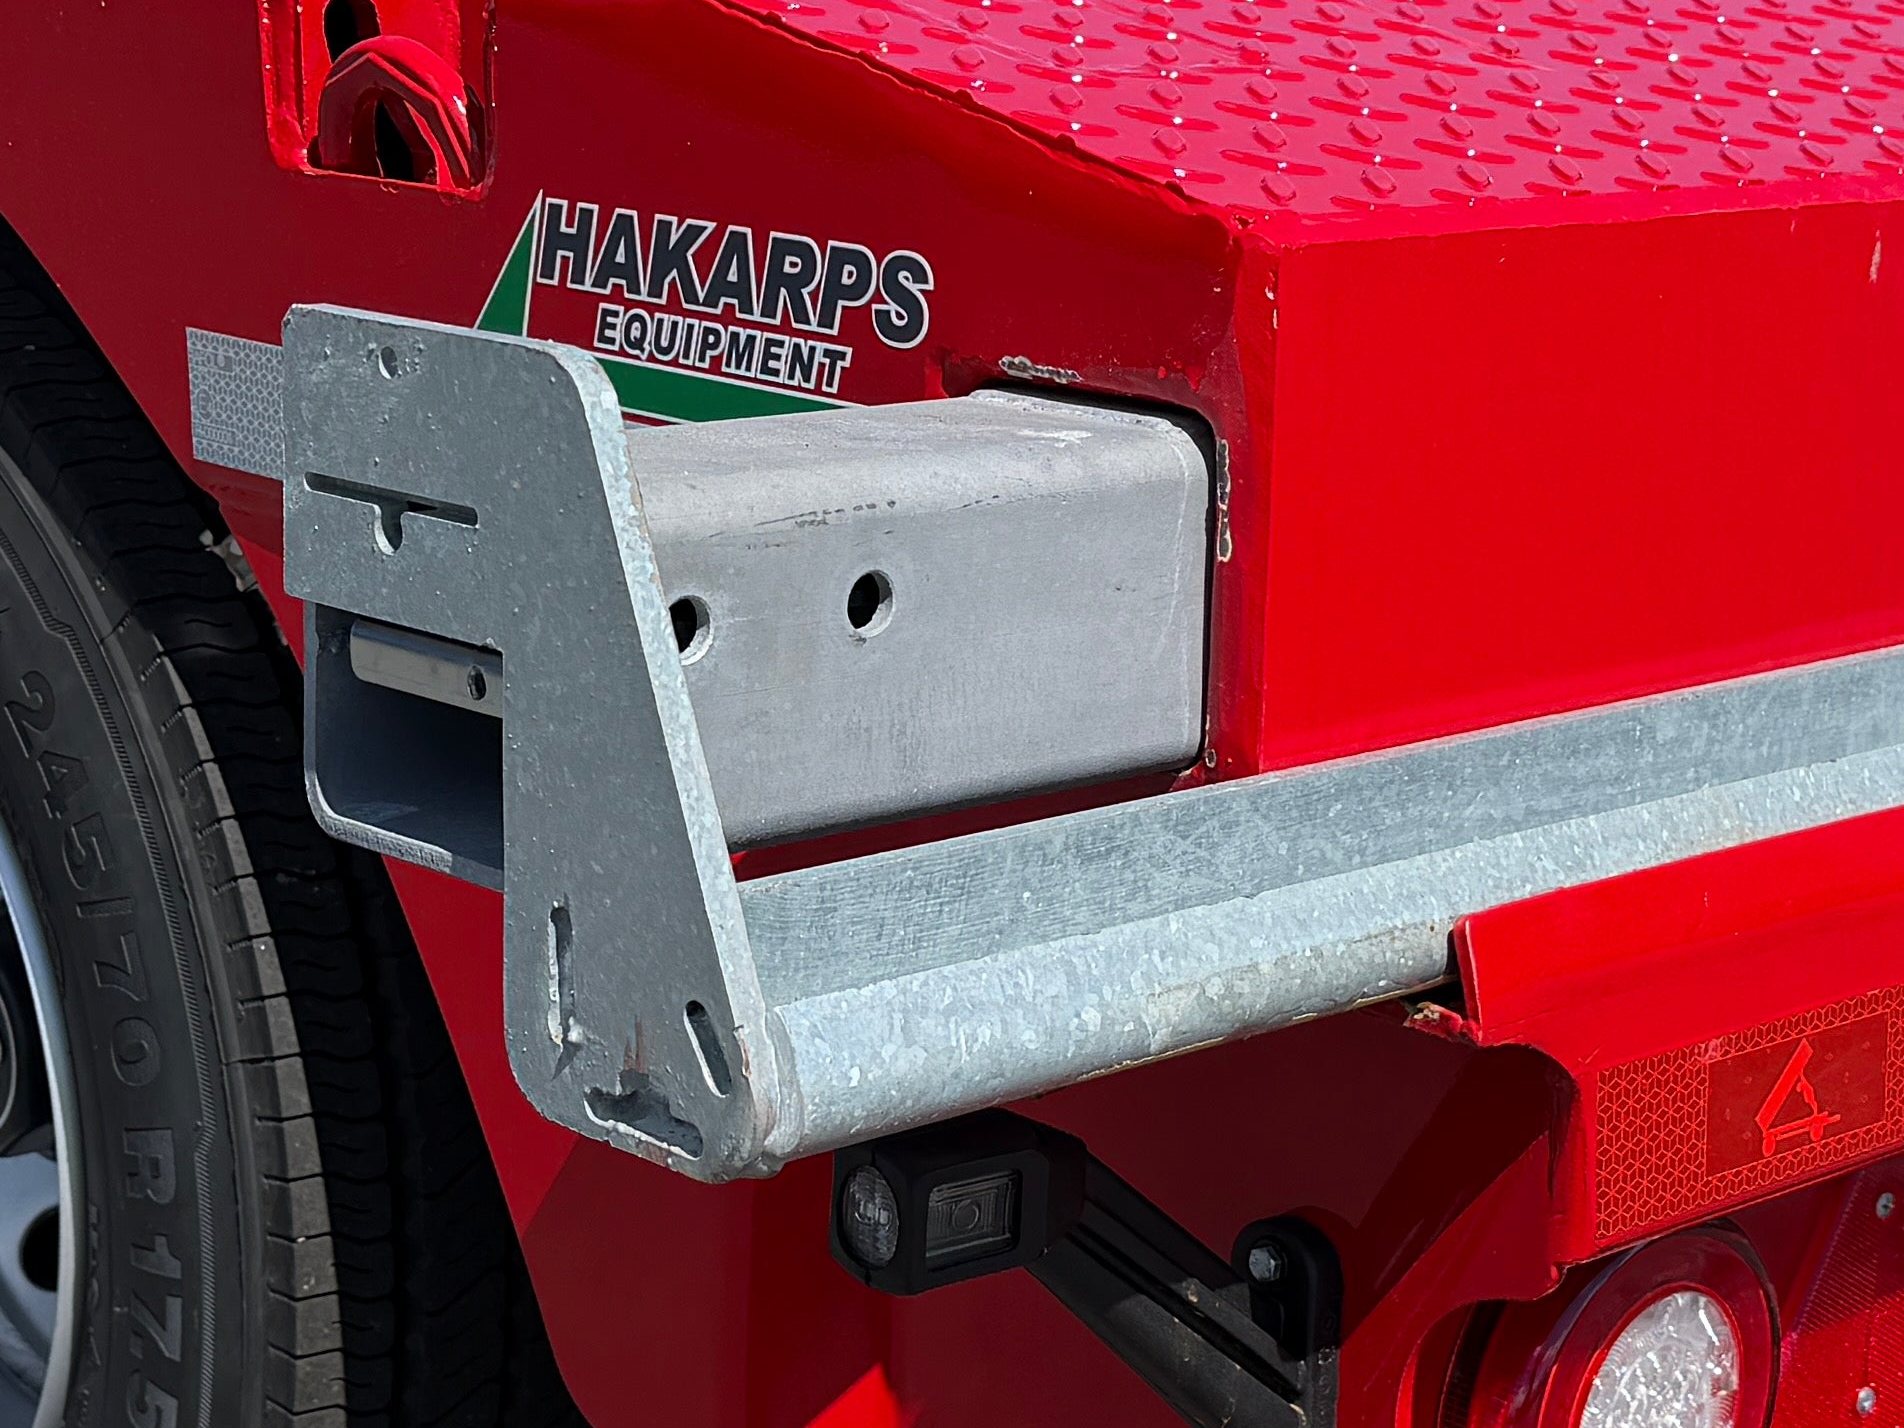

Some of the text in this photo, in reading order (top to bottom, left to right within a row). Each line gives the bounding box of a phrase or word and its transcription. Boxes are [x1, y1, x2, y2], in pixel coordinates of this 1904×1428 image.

[537, 197, 934, 349] HAKARPS
[594, 303, 852, 394] EQUIPMENT
[2, 669, 164, 1088] 245/70
